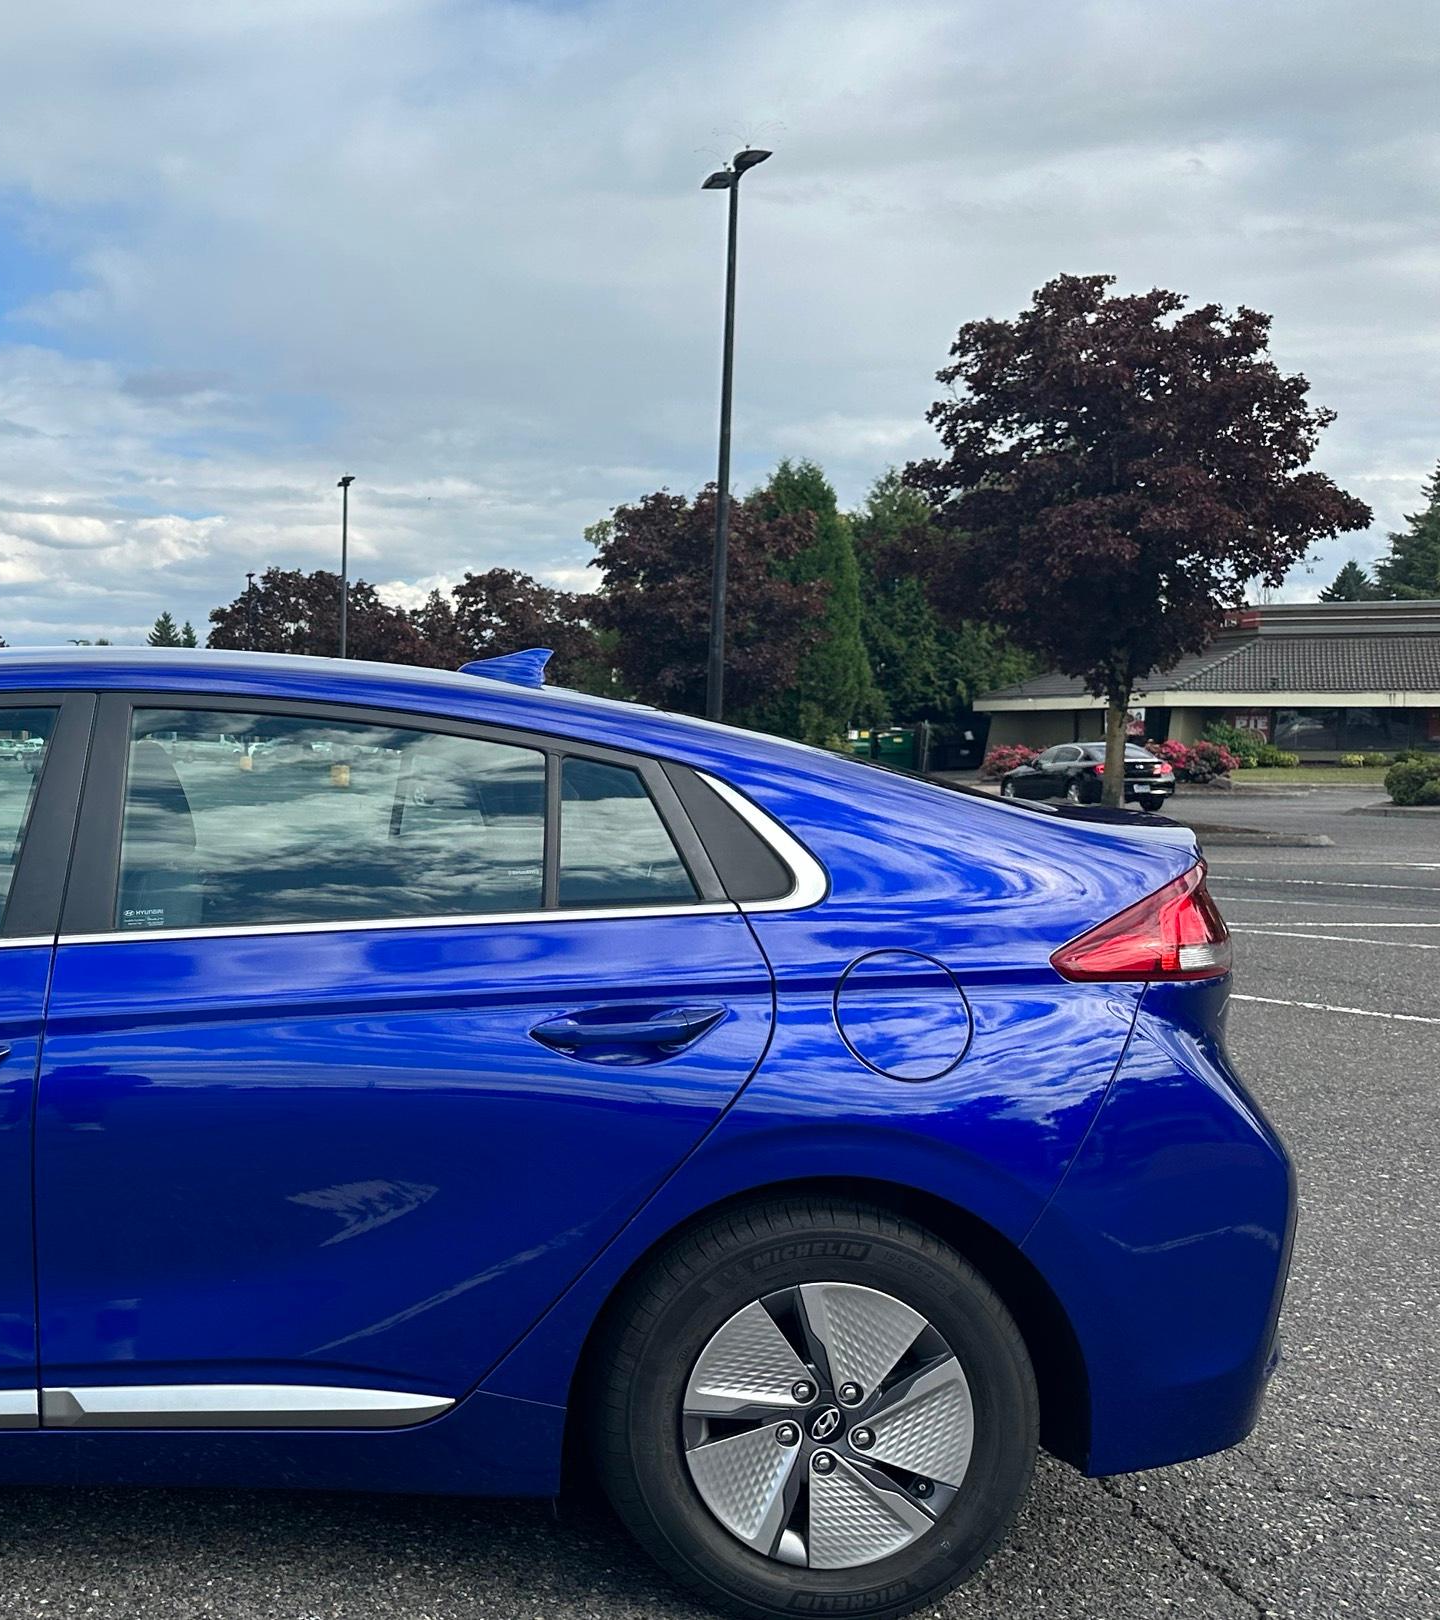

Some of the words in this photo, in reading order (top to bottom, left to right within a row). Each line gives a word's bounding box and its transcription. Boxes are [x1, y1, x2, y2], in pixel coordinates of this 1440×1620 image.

[1235, 716, 1268, 729] PIE
[753, 1241, 866, 1268] MICHELIN
[792, 1580, 908, 1611] MICHELIN
